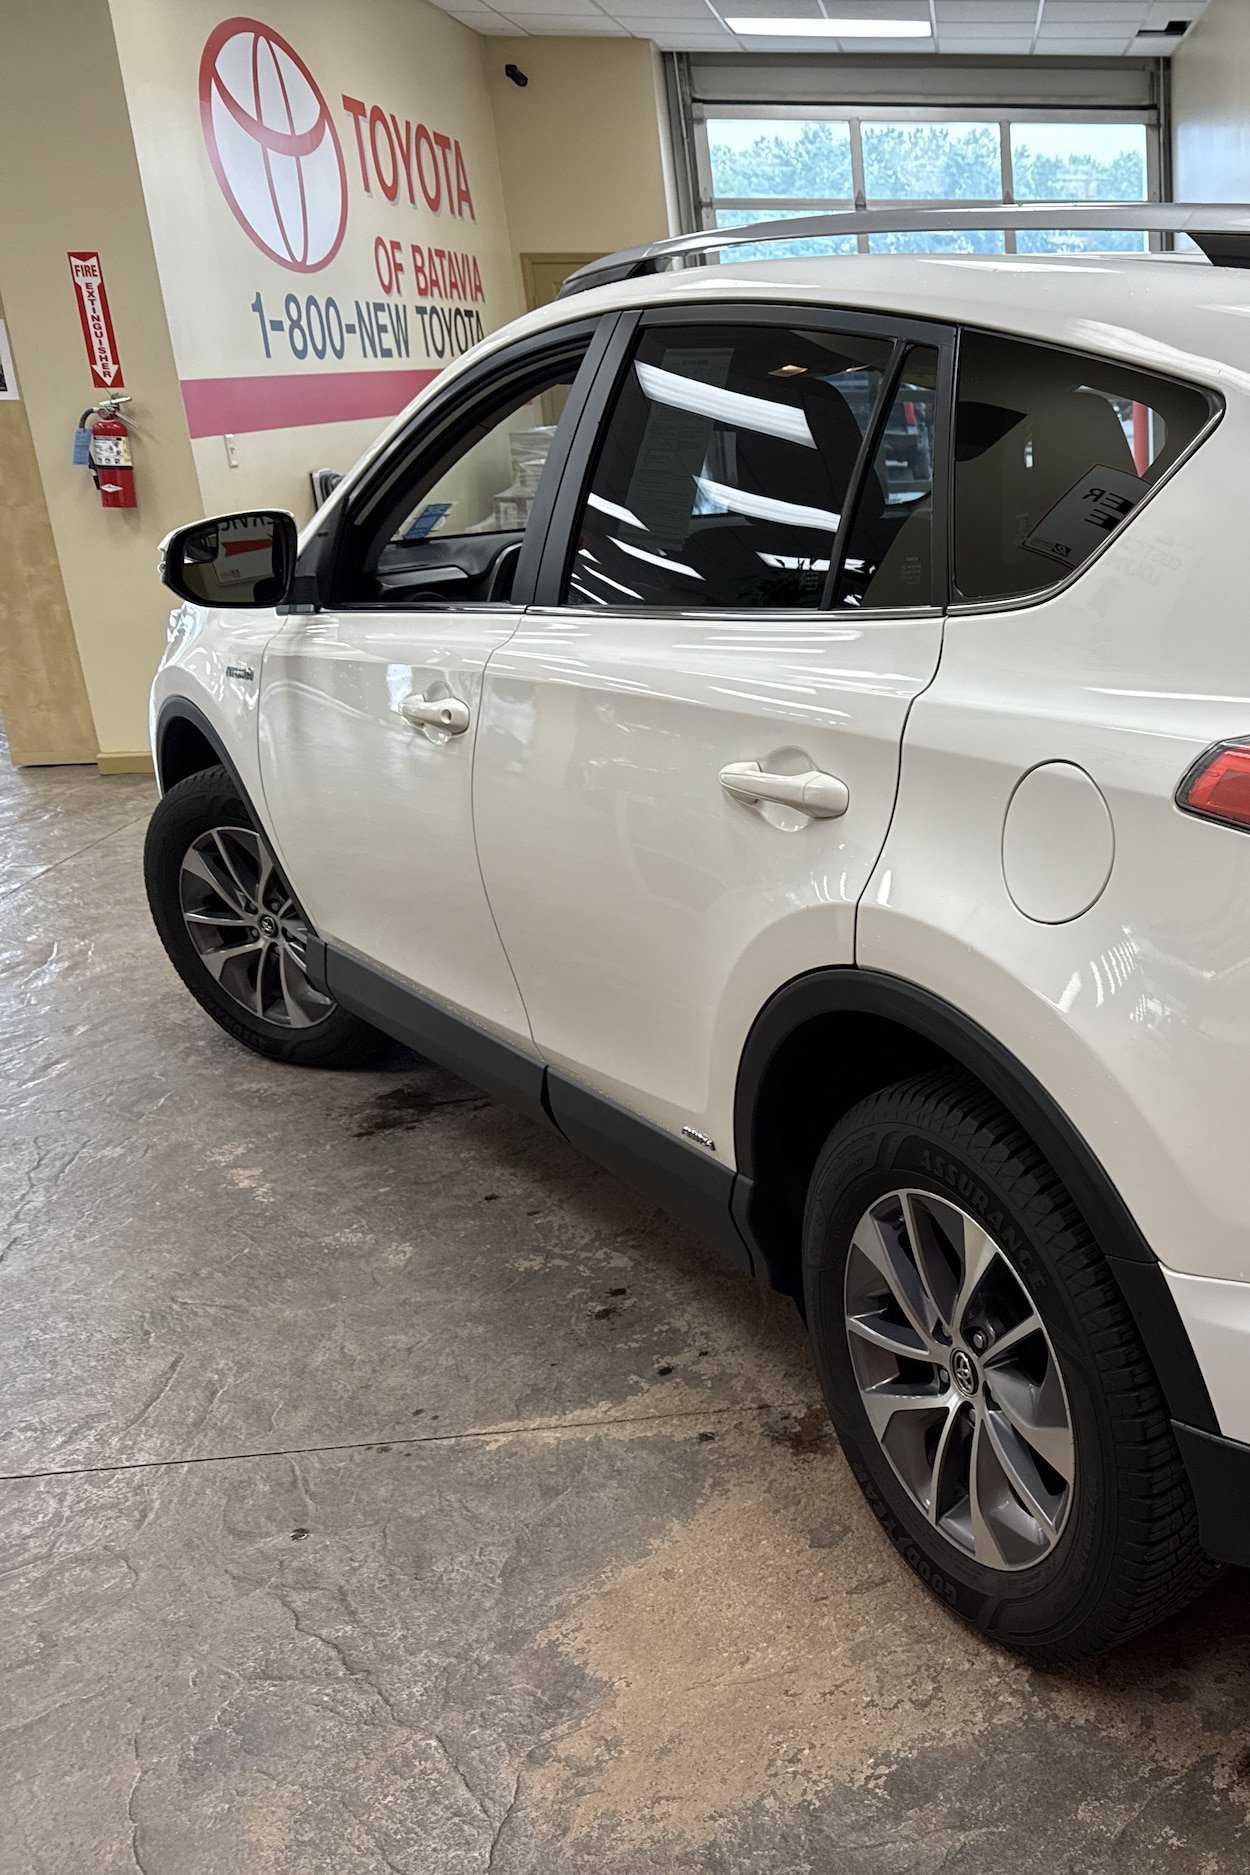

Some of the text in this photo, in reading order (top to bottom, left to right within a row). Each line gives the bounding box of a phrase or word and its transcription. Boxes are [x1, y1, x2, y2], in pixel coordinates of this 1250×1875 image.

[342, 94, 476, 221] TOYOTA
[74, 264, 98, 277] FIRE
[374, 235, 485, 302] OF BATAVIA
[85, 282, 112, 378] EXTINGUISHER
[251, 291, 410, 360] 1-800-NEW
[918, 1150, 1048, 1290] ASSURANCE
